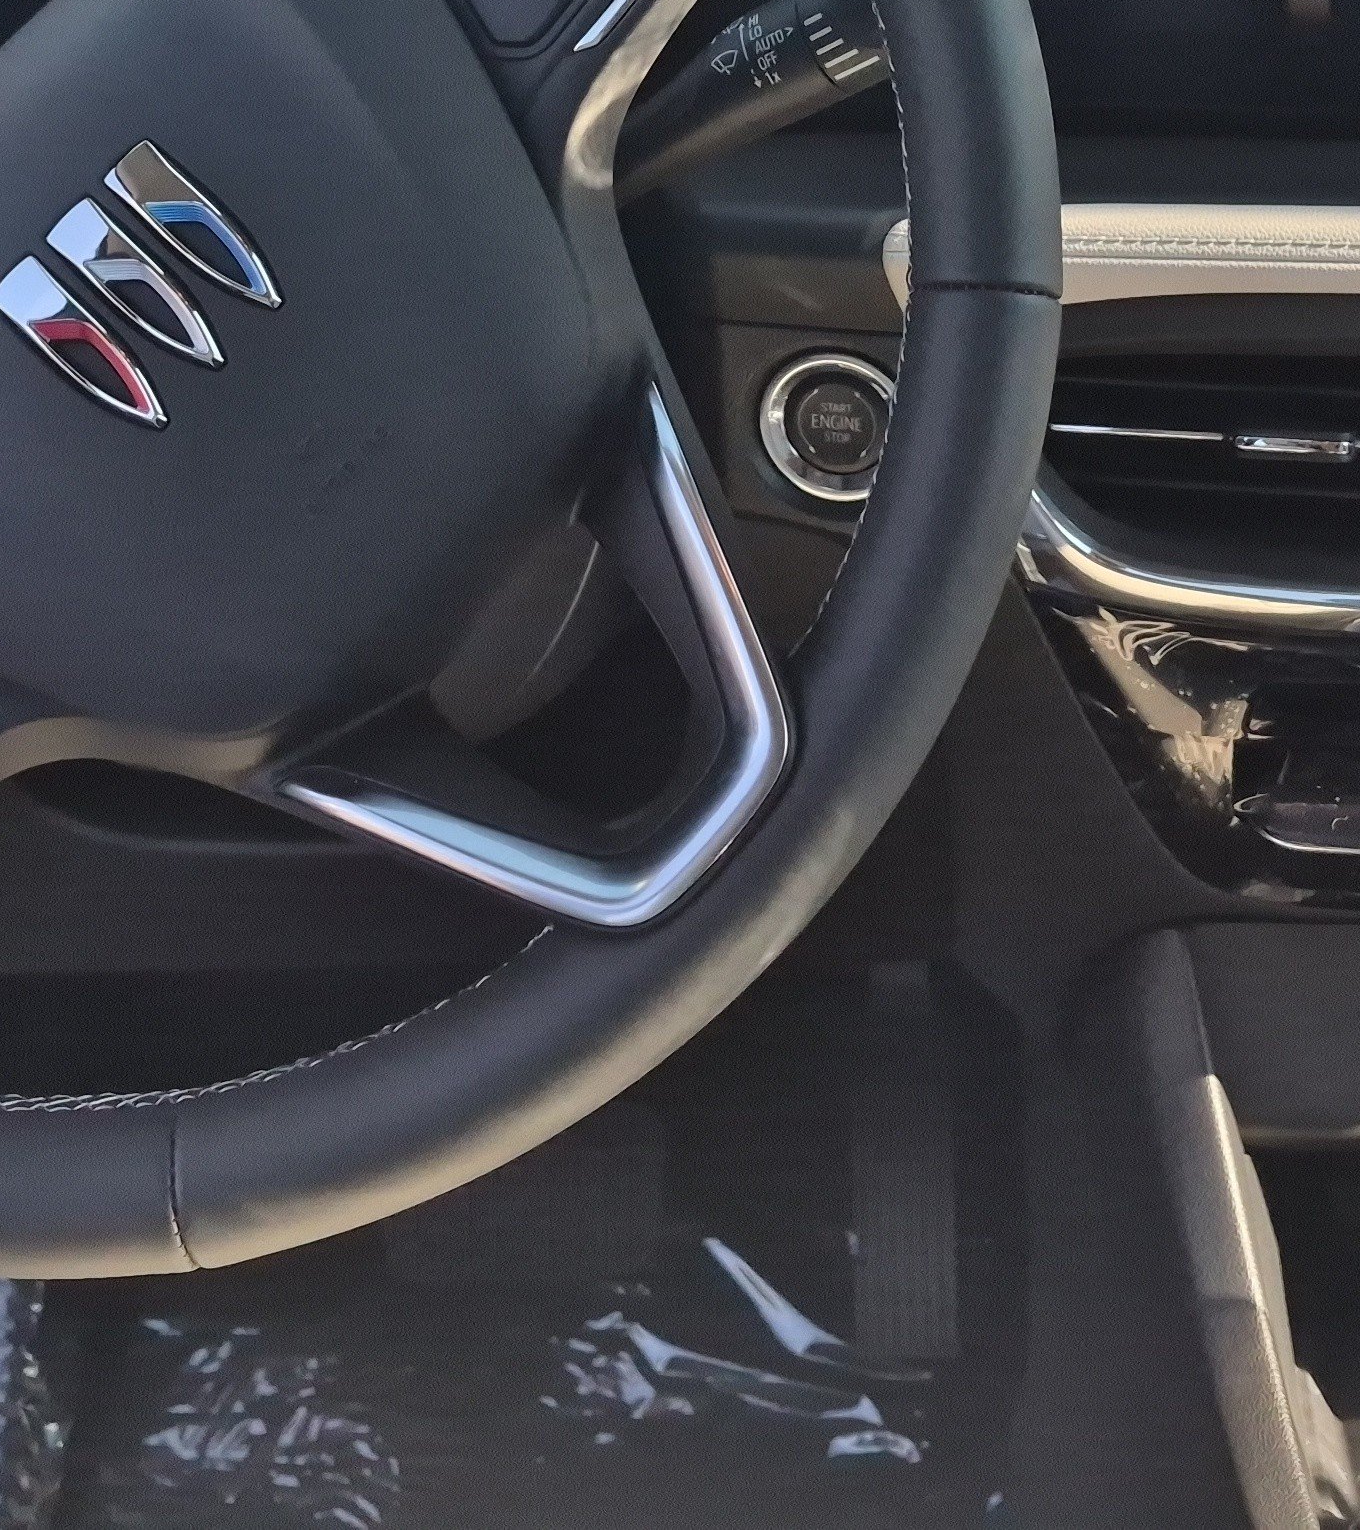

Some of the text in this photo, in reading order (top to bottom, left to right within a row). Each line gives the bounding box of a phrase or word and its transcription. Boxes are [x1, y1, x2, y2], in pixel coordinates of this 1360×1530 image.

[747, 13, 759, 28] HI
[749, 25, 762, 41] LO
[755, 28, 784, 55] AUTO
[757, 50, 777, 71] OFF
[820, 401, 852, 413] START
[811, 412, 862, 433] ENGINE
[824, 429, 851, 443] STOP
